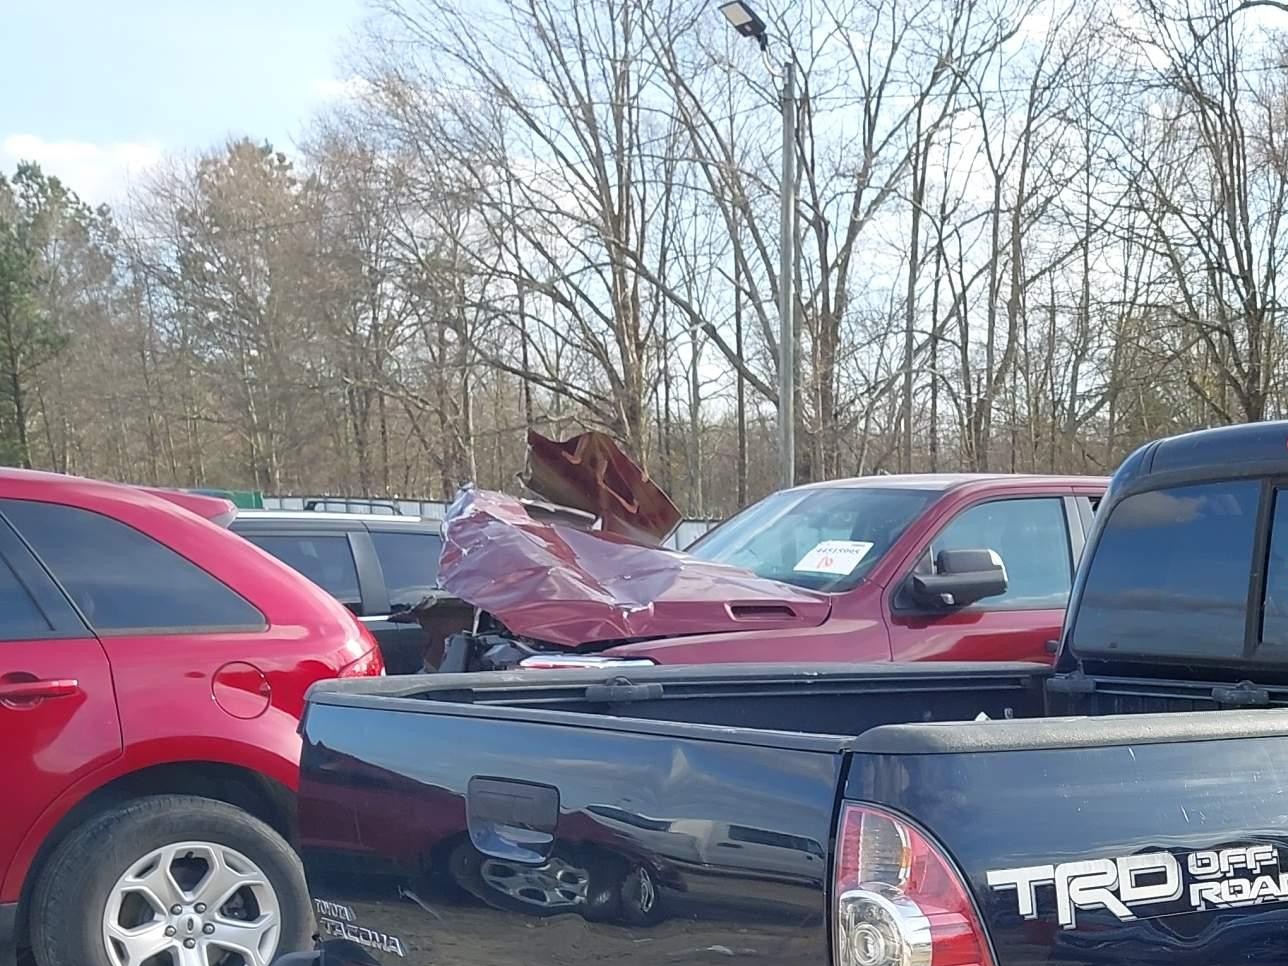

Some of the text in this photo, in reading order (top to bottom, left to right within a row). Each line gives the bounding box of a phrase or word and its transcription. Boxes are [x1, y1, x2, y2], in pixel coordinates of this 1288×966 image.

[987, 845, 1278, 930] TRD OFF
[320, 917, 407, 957] TACOMA
